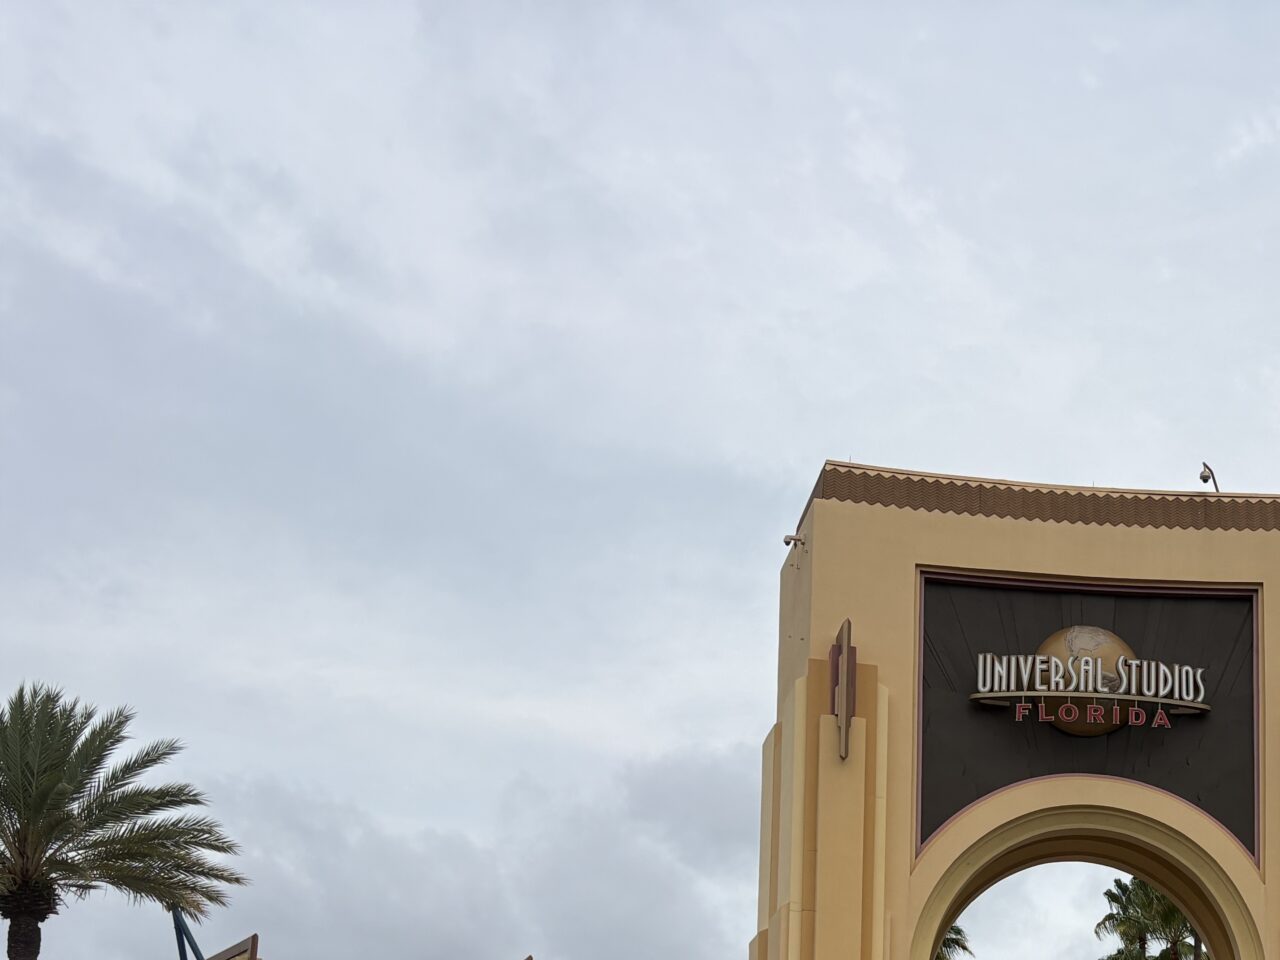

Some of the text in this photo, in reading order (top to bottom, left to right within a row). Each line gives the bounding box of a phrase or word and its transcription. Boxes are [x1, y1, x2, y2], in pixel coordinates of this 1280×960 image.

[978, 654, 1206, 702] UNIVERSAL STUDIOS
[1015, 704, 1172, 728] FLORIDA
